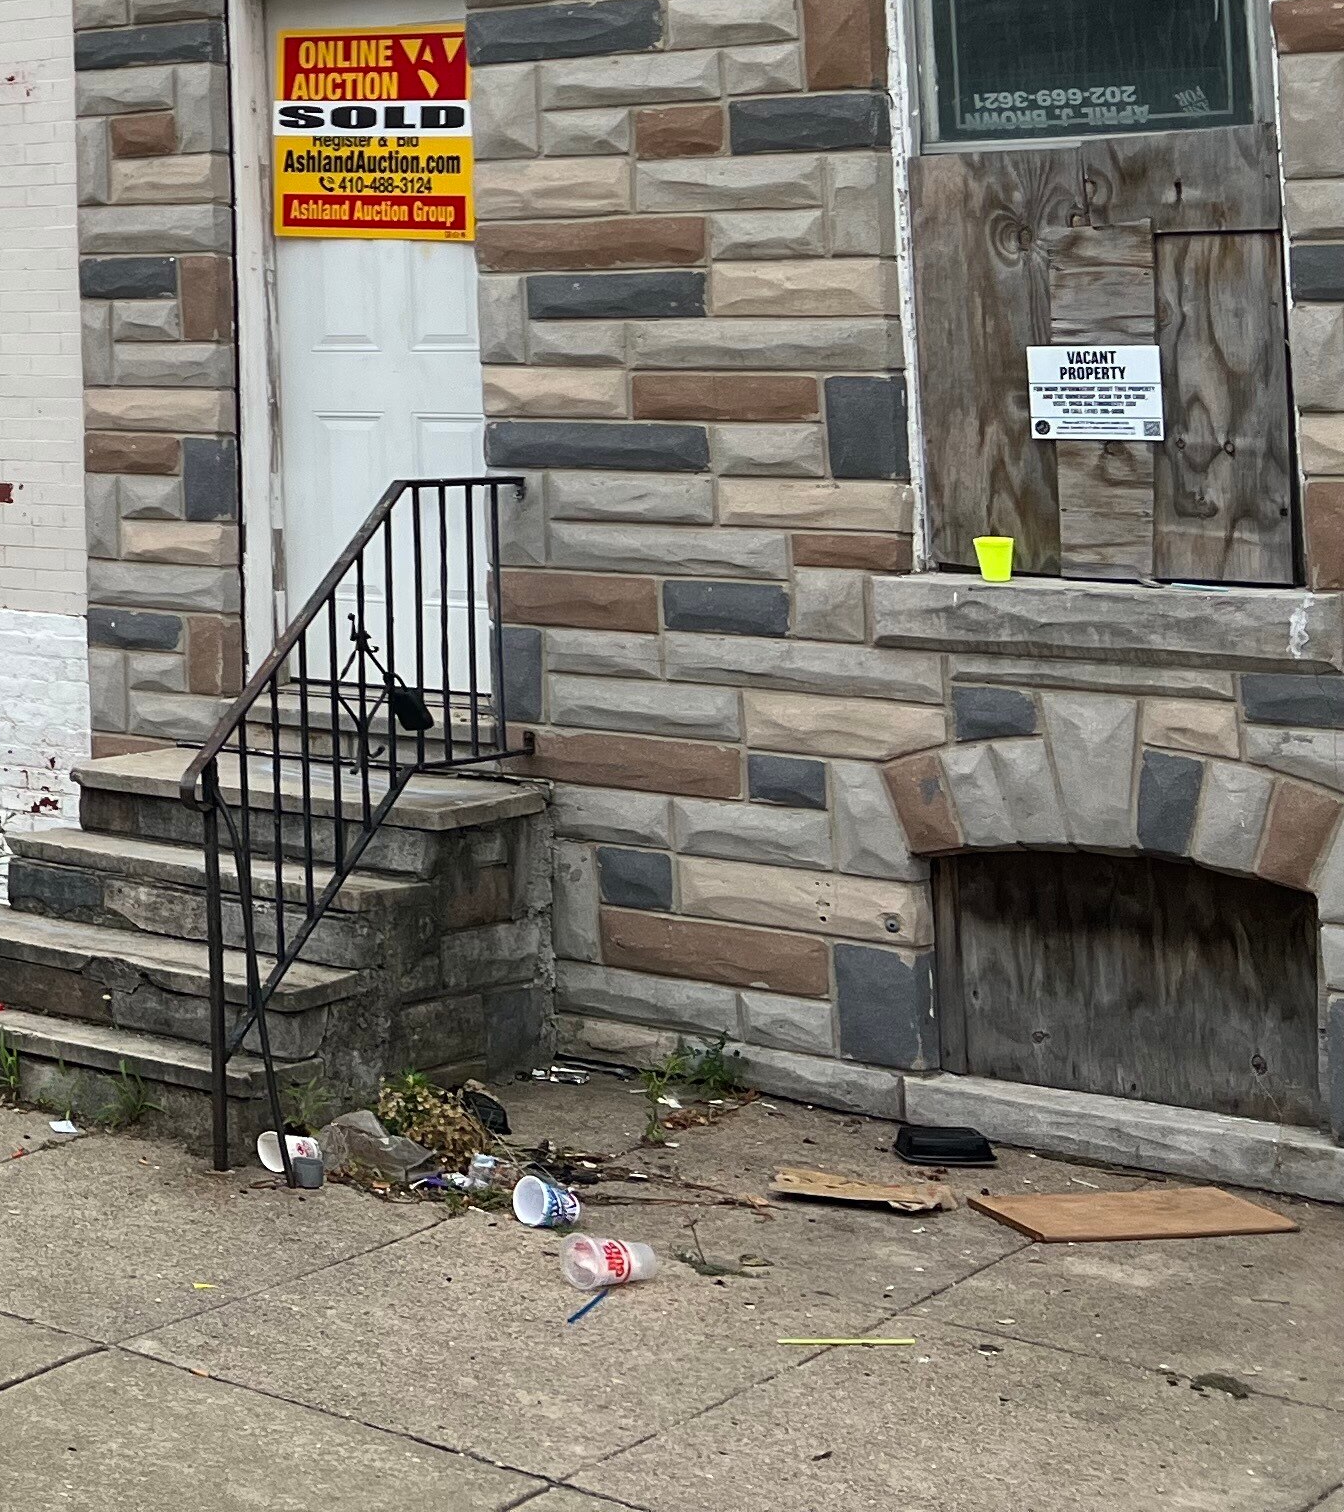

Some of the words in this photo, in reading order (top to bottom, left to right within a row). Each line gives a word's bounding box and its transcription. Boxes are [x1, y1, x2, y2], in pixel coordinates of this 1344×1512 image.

[298, 39, 393, 69] ONLINE
[290, 71, 399, 100] AUCTION
[973, 85, 1137, 109] 202-669-3621
[278, 105, 465, 129] SOLD
[283, 149, 461, 174] AshlandAuction.com
[338, 176, 433, 194] 410-488-3124
[290, 199, 350, 221] Ashland
[353, 200, 409, 223] Auction
[413, 201, 455, 227] Group
[1067, 350, 1117, 365] VACANT
[1059, 366, 1126, 380] PROPERTY
